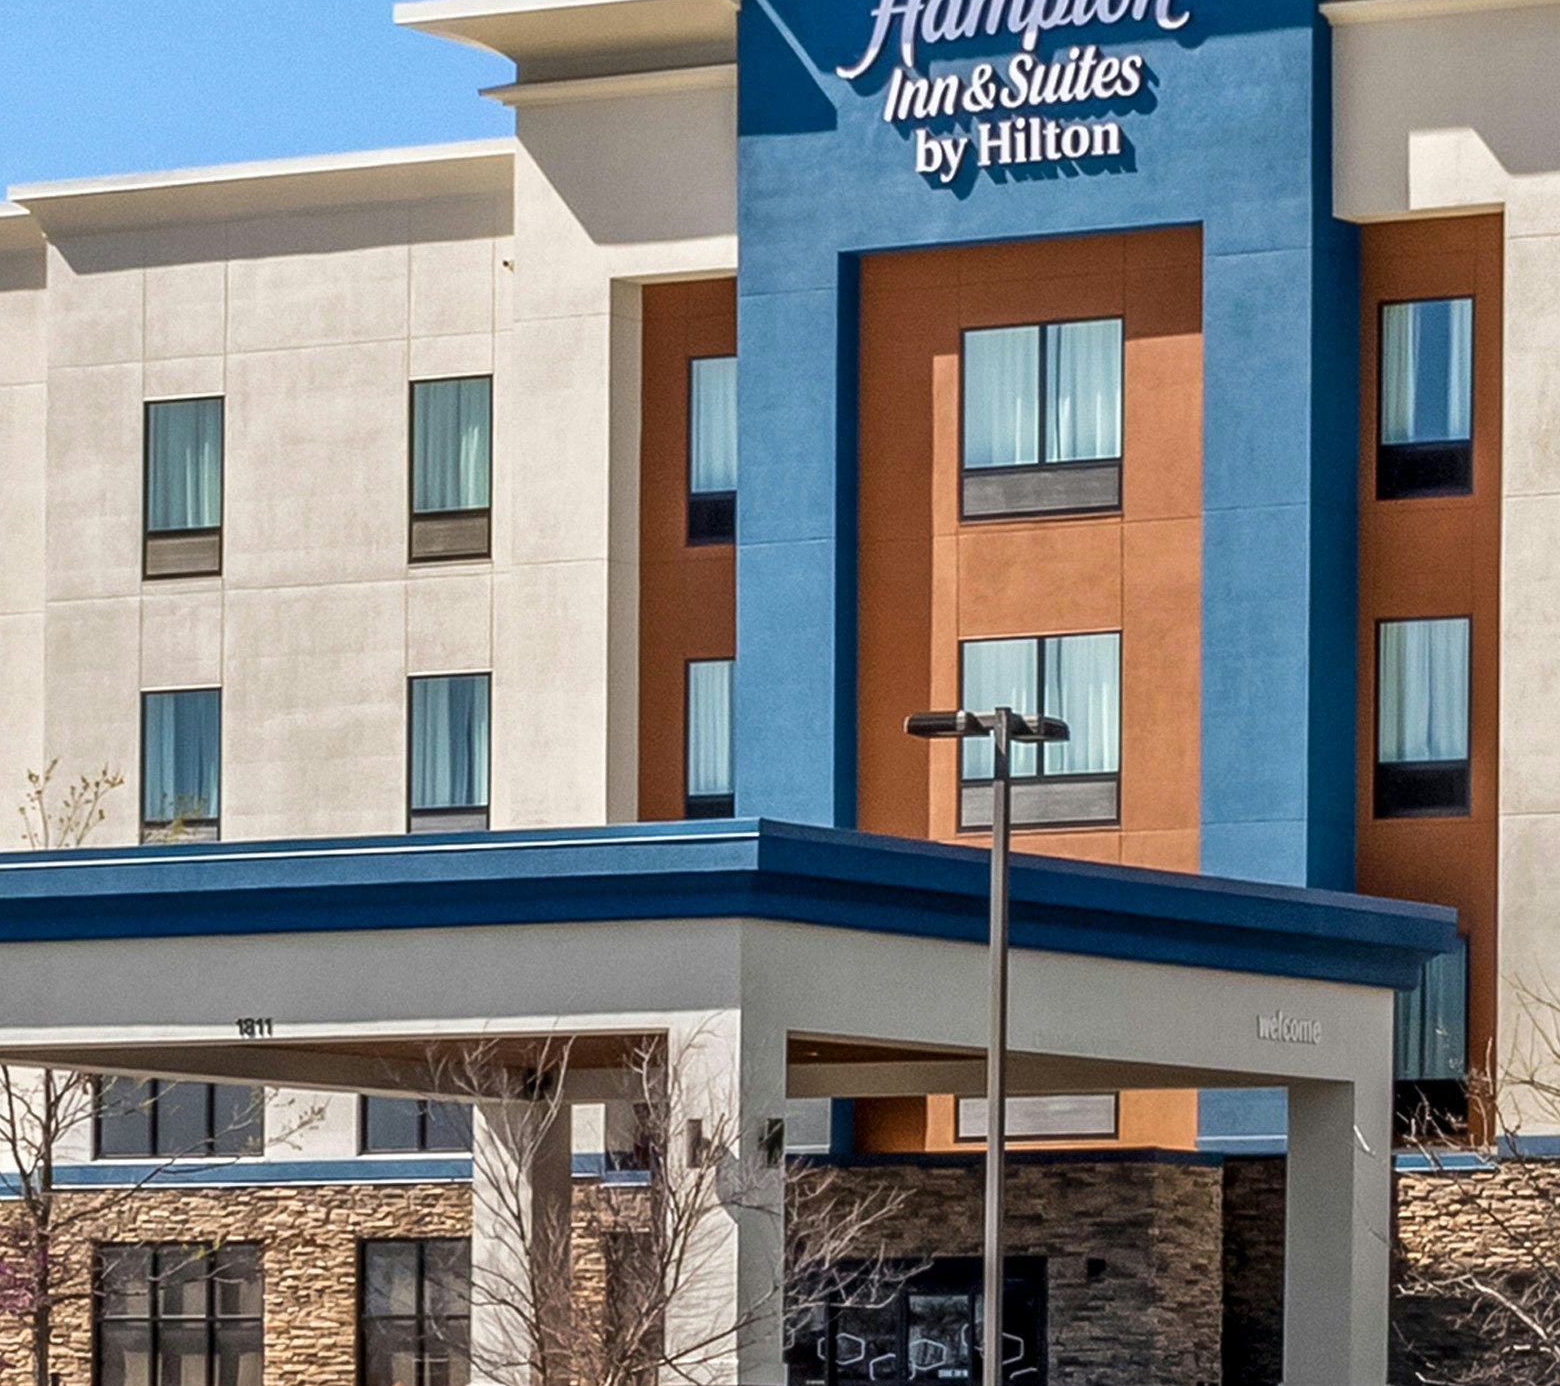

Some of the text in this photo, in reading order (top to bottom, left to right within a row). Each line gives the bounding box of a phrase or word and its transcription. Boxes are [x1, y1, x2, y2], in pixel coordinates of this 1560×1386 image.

[915, 117, 1121, 183] by Hilton
[1256, 1010, 1322, 1045] welcome
